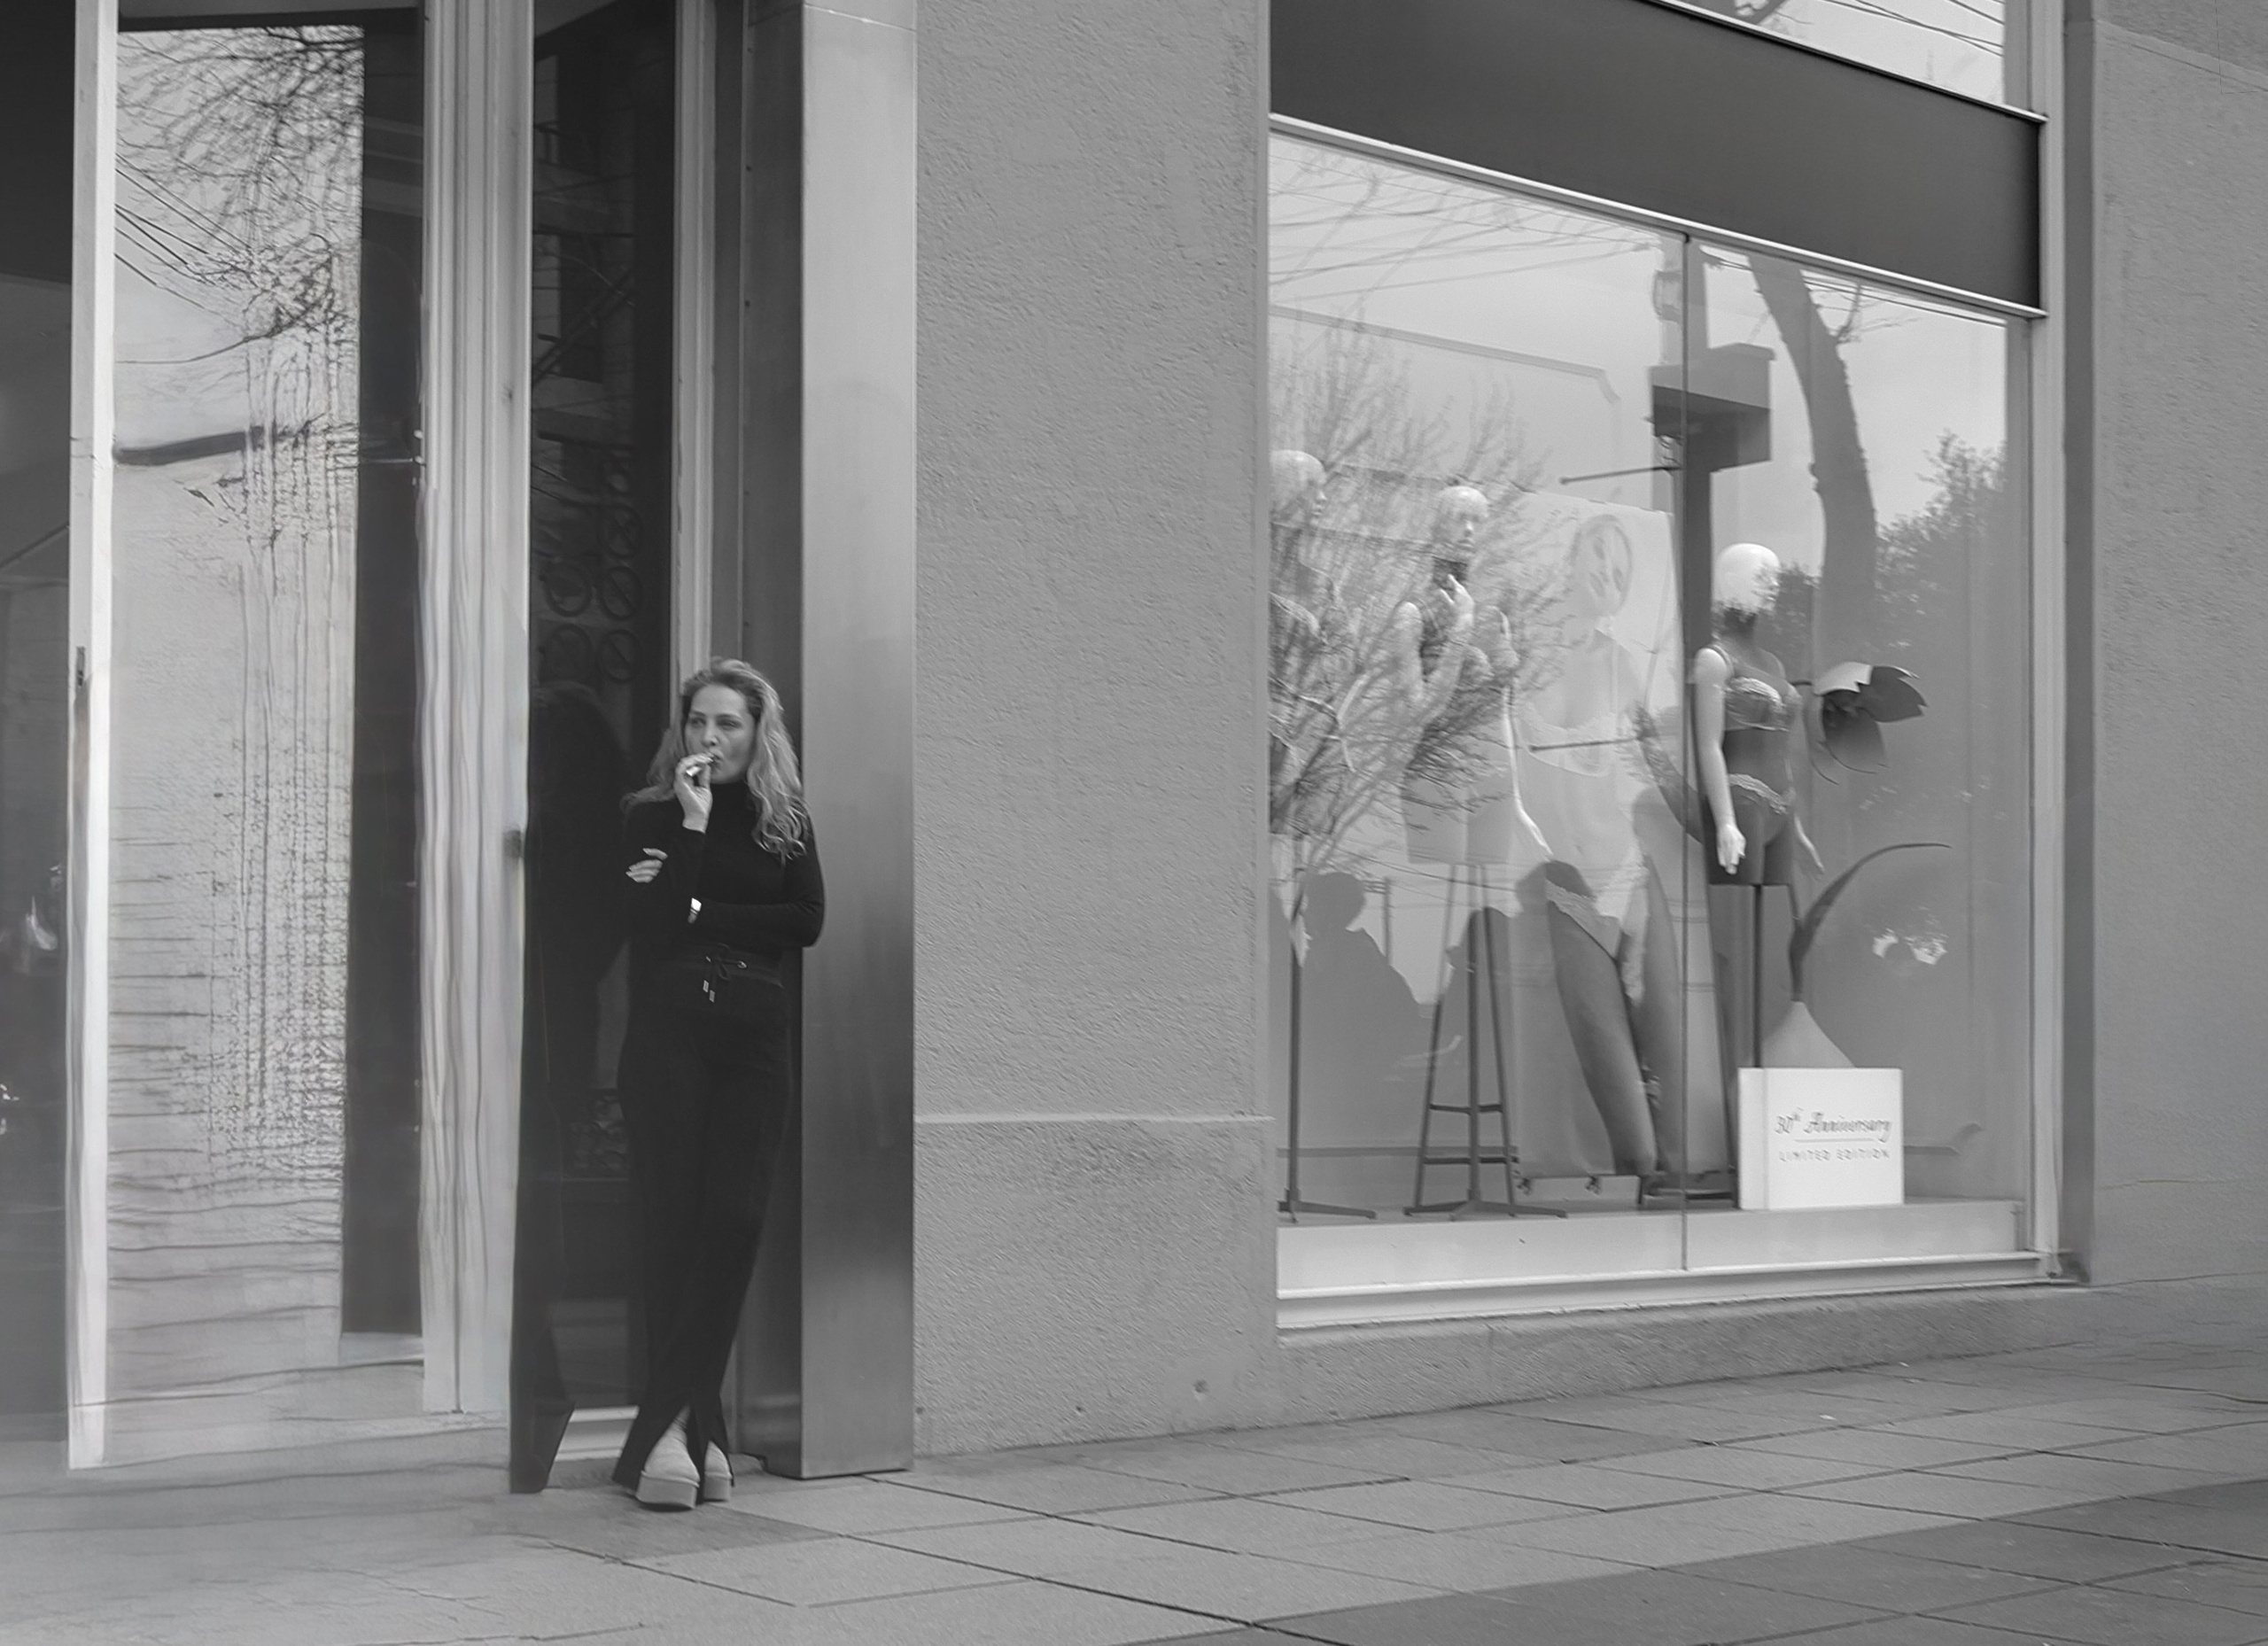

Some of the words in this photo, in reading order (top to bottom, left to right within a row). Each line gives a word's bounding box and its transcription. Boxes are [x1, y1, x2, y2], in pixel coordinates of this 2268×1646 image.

[1804, 1111, 1892, 1143] Anniversary
[1778, 1149, 1830, 1162] LIMITED
[1837, 1147, 1890, 1161] EDITION
